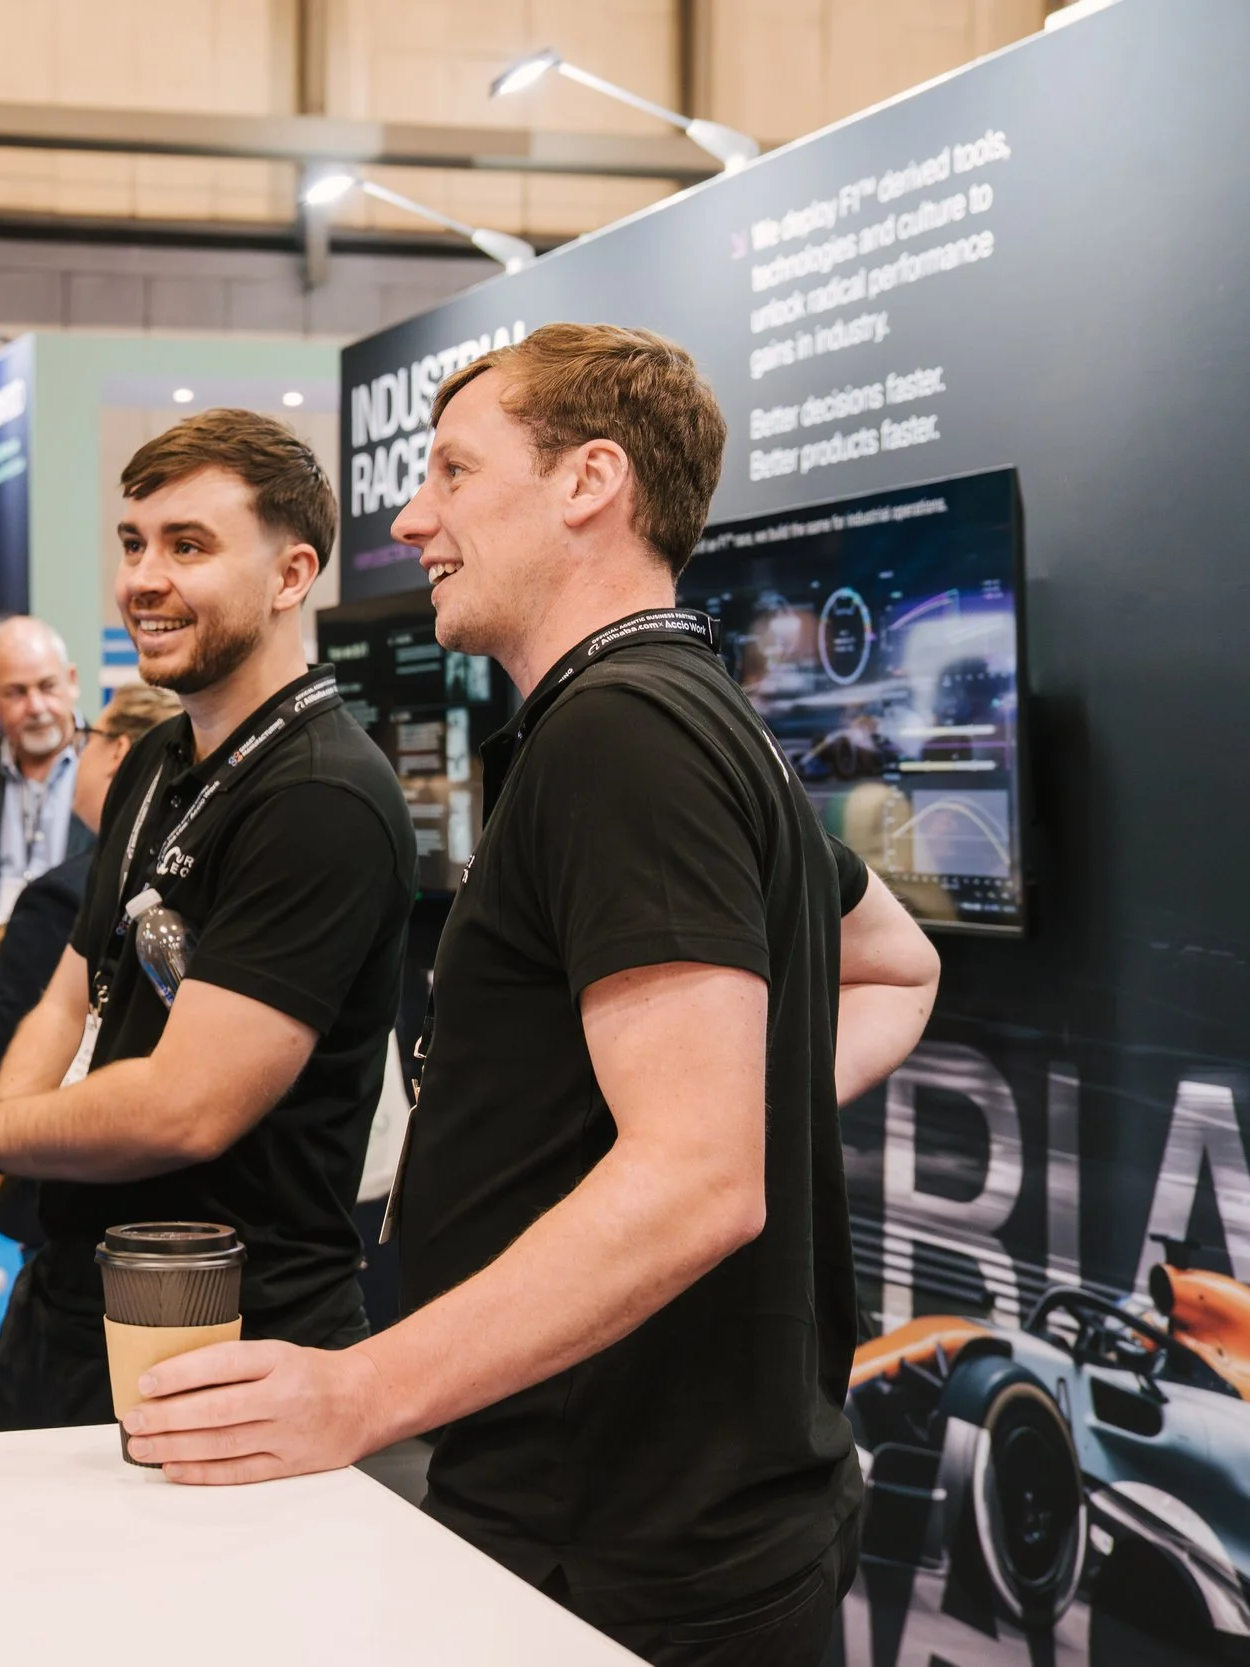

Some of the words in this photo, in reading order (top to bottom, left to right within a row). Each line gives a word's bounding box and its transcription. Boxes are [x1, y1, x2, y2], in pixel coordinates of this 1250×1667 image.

[780, 199, 838, 241] deploy
[876, 146, 950, 203] derived
[751, 233, 858, 292] technologies
[858, 213, 896, 255] and
[896, 193, 967, 240] culture
[968, 183, 993, 214] to
[750, 289, 806, 334] unlock
[806, 267, 867, 315] radical
[867, 230, 994, 300] performance
[750, 338, 795, 379] gains
[795, 330, 814, 360] in
[813, 311, 890, 354] industry.
[750, 404, 800, 440] Better
[800, 385, 884, 427] decisions
[885, 366, 946, 405] faster.
[351, 431, 435, 517] RACE
[750, 447, 800, 481] Better
[800, 429, 879, 474] products
[881, 414, 941, 450] faster.
[591, 627, 619, 645] OFFICIAL
[619, 616, 646, 630] AGENTIC
[646, 612, 675, 621] BUSINESS
[675, 613, 697, 621] PARTNER
[601, 622, 659, 646] Alibaba.com
[665, 619, 690, 631] Accio
[689, 621, 707, 636] Work
